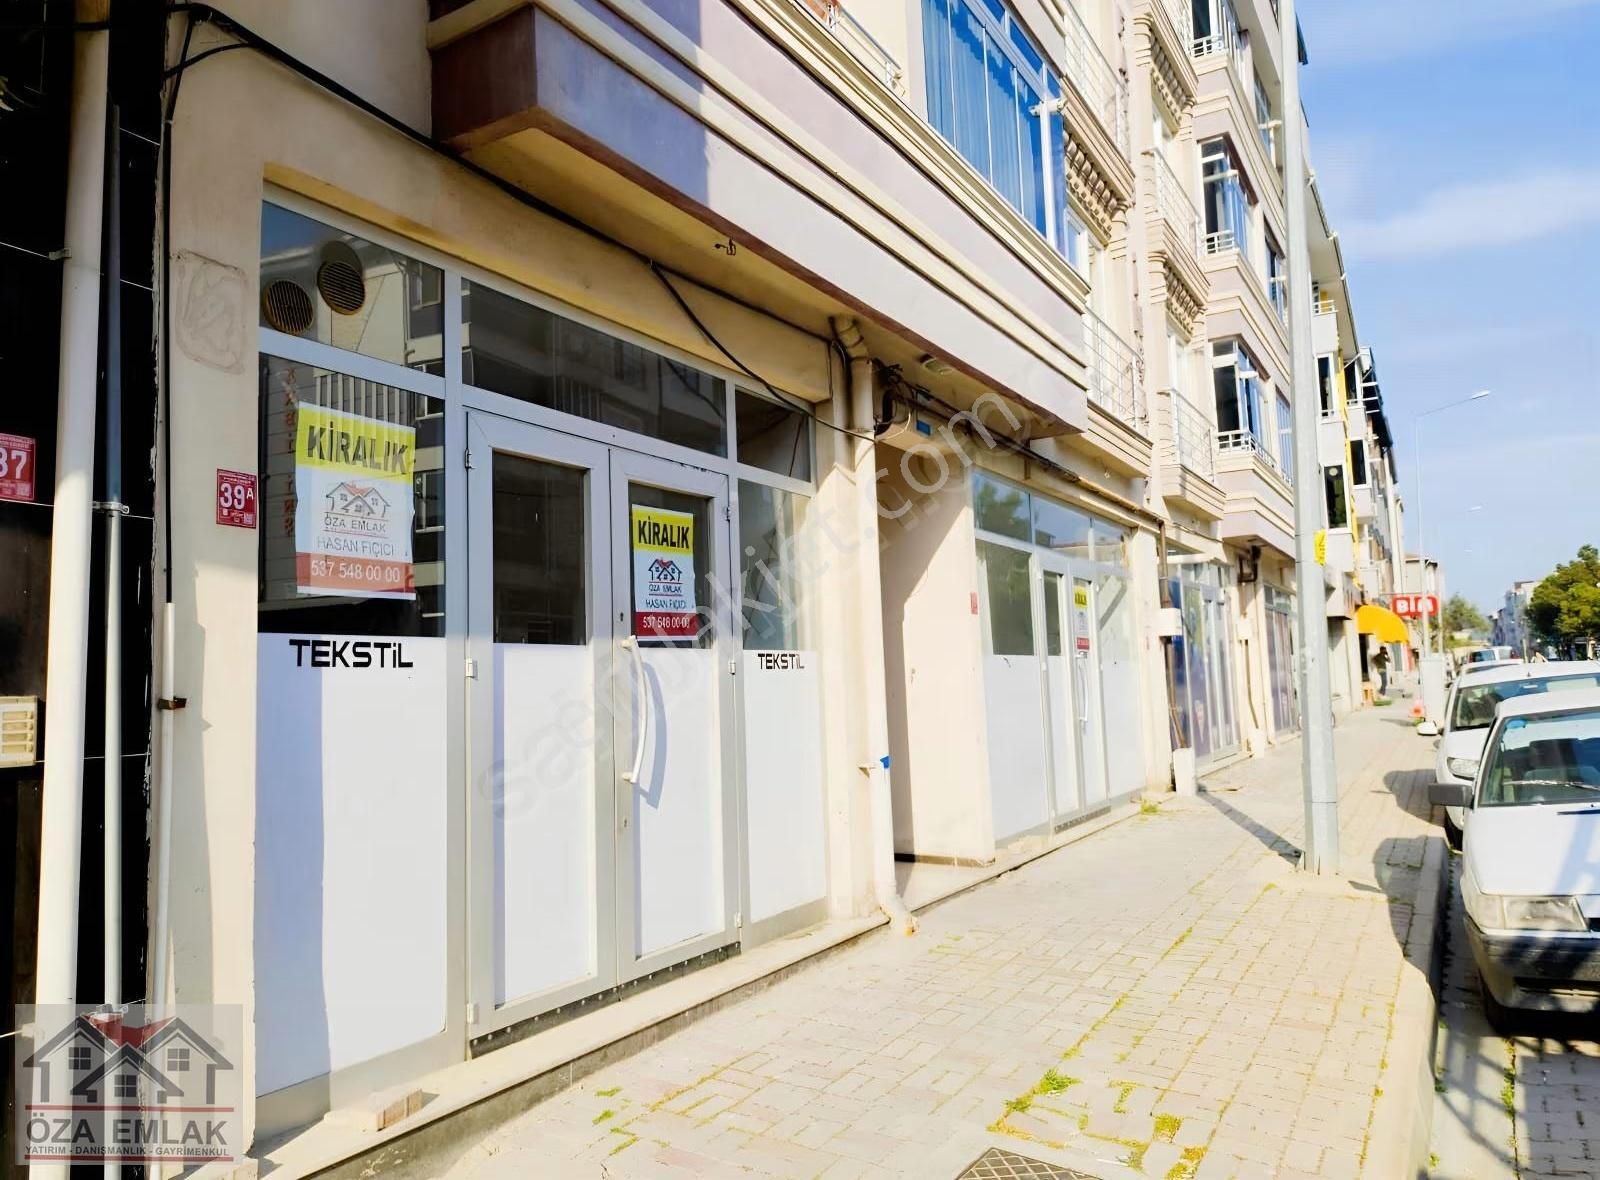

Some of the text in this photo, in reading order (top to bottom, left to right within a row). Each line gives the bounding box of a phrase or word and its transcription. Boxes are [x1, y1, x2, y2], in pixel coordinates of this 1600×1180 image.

[307, 421, 408, 475] KİRALIK
[220, 482, 254, 510] 39 A
[351, 519, 386, 533] EMLAK
[638, 516, 690, 549] KİRALIK
[317, 536, 358, 553] HASAN
[311, 560, 400, 582] 537 548 00 00
